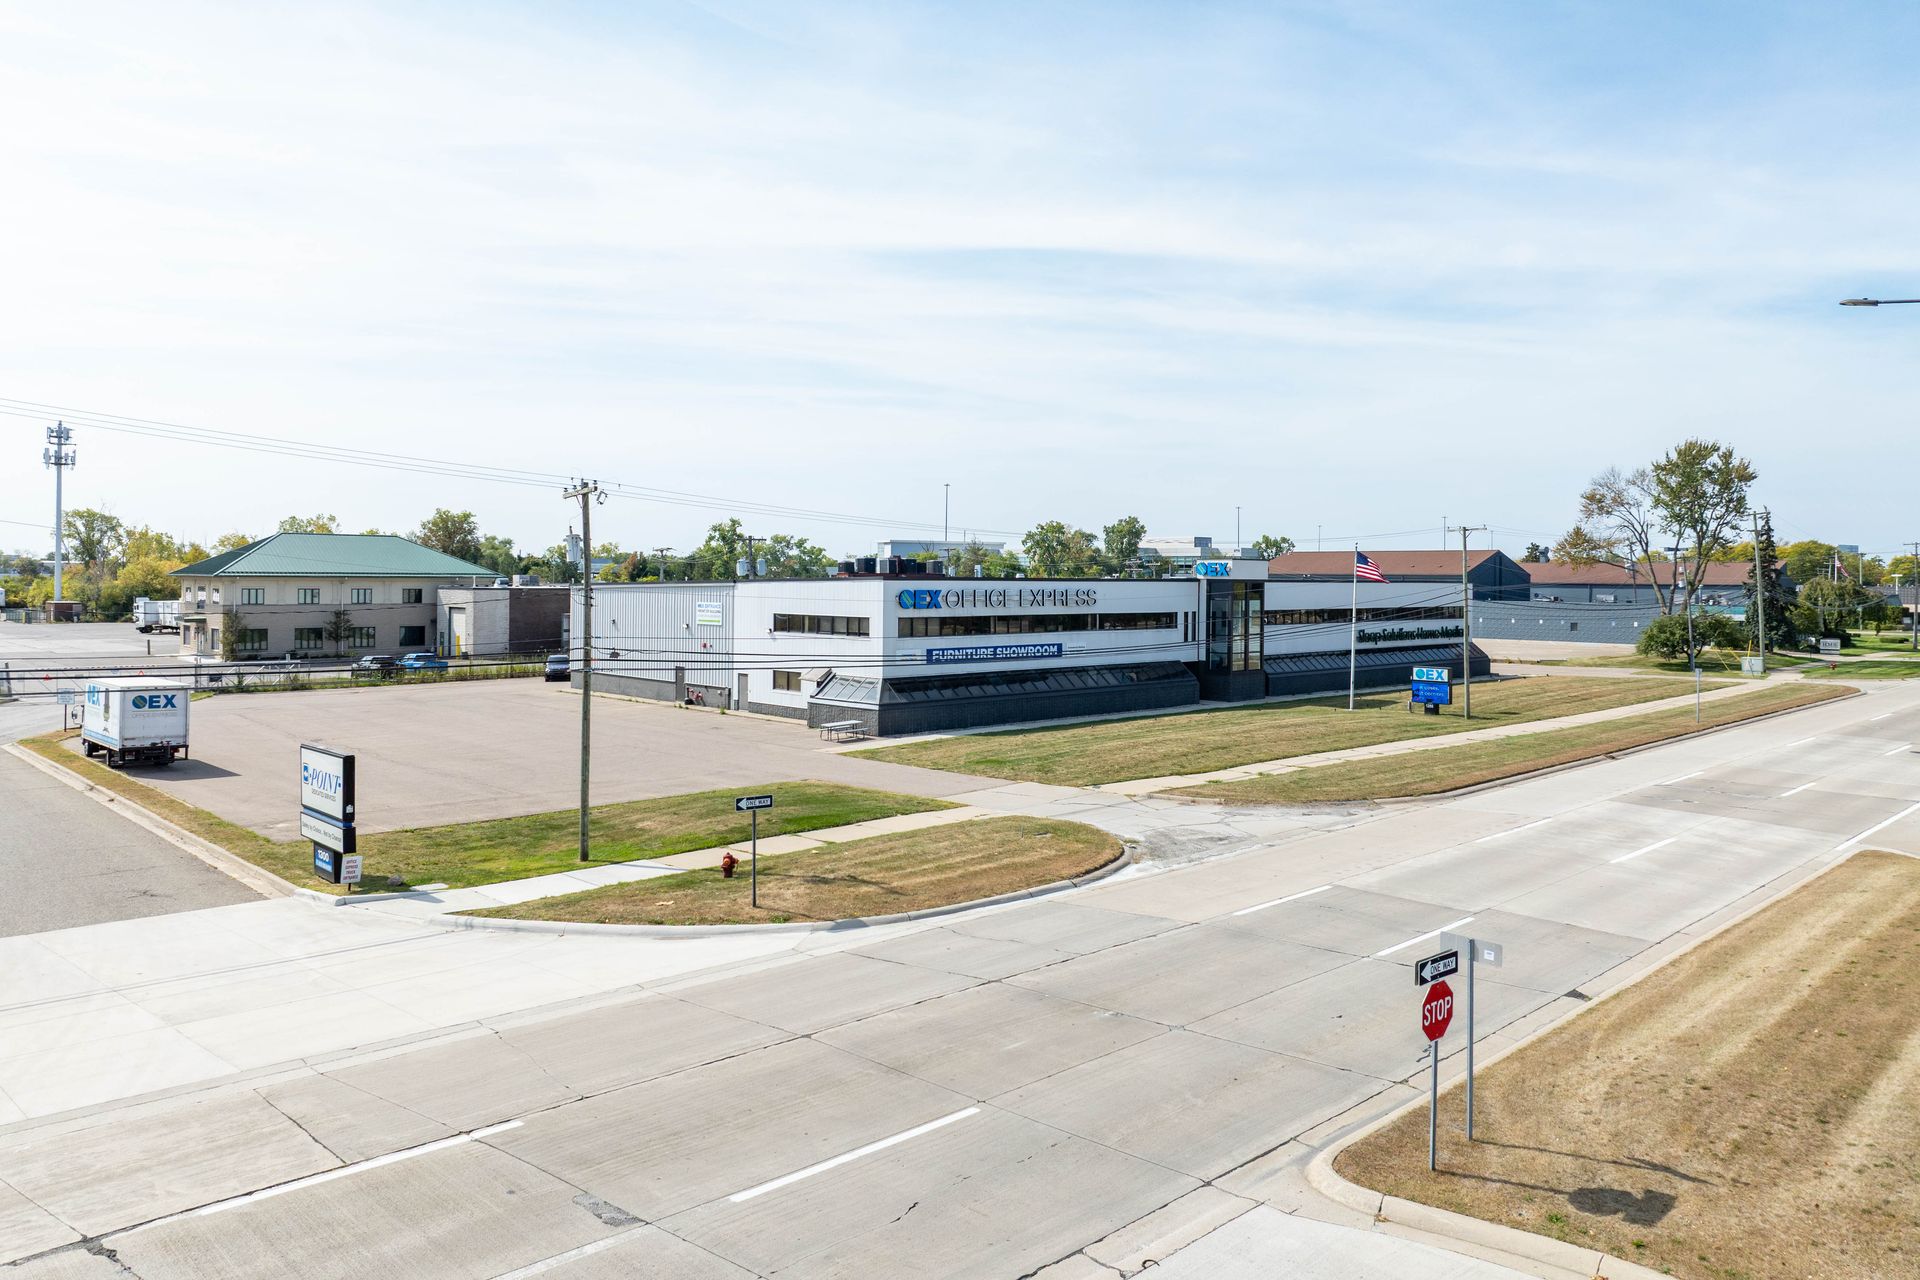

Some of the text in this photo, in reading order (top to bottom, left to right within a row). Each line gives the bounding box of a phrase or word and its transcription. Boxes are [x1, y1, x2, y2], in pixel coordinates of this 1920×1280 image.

[1196, 562, 1229, 577] OEX
[898, 588, 1097, 609] OEX OFFICE EXPRESS
[932, 648, 994, 662] FURNITURE
[996, 645, 1058, 659] SHOWROOM
[1415, 668, 1445, 681] OEX
[132, 694, 177, 709] OEX
[1430, 958, 1454, 975] ONE WAY
[1423, 996, 1452, 1026] STOP
